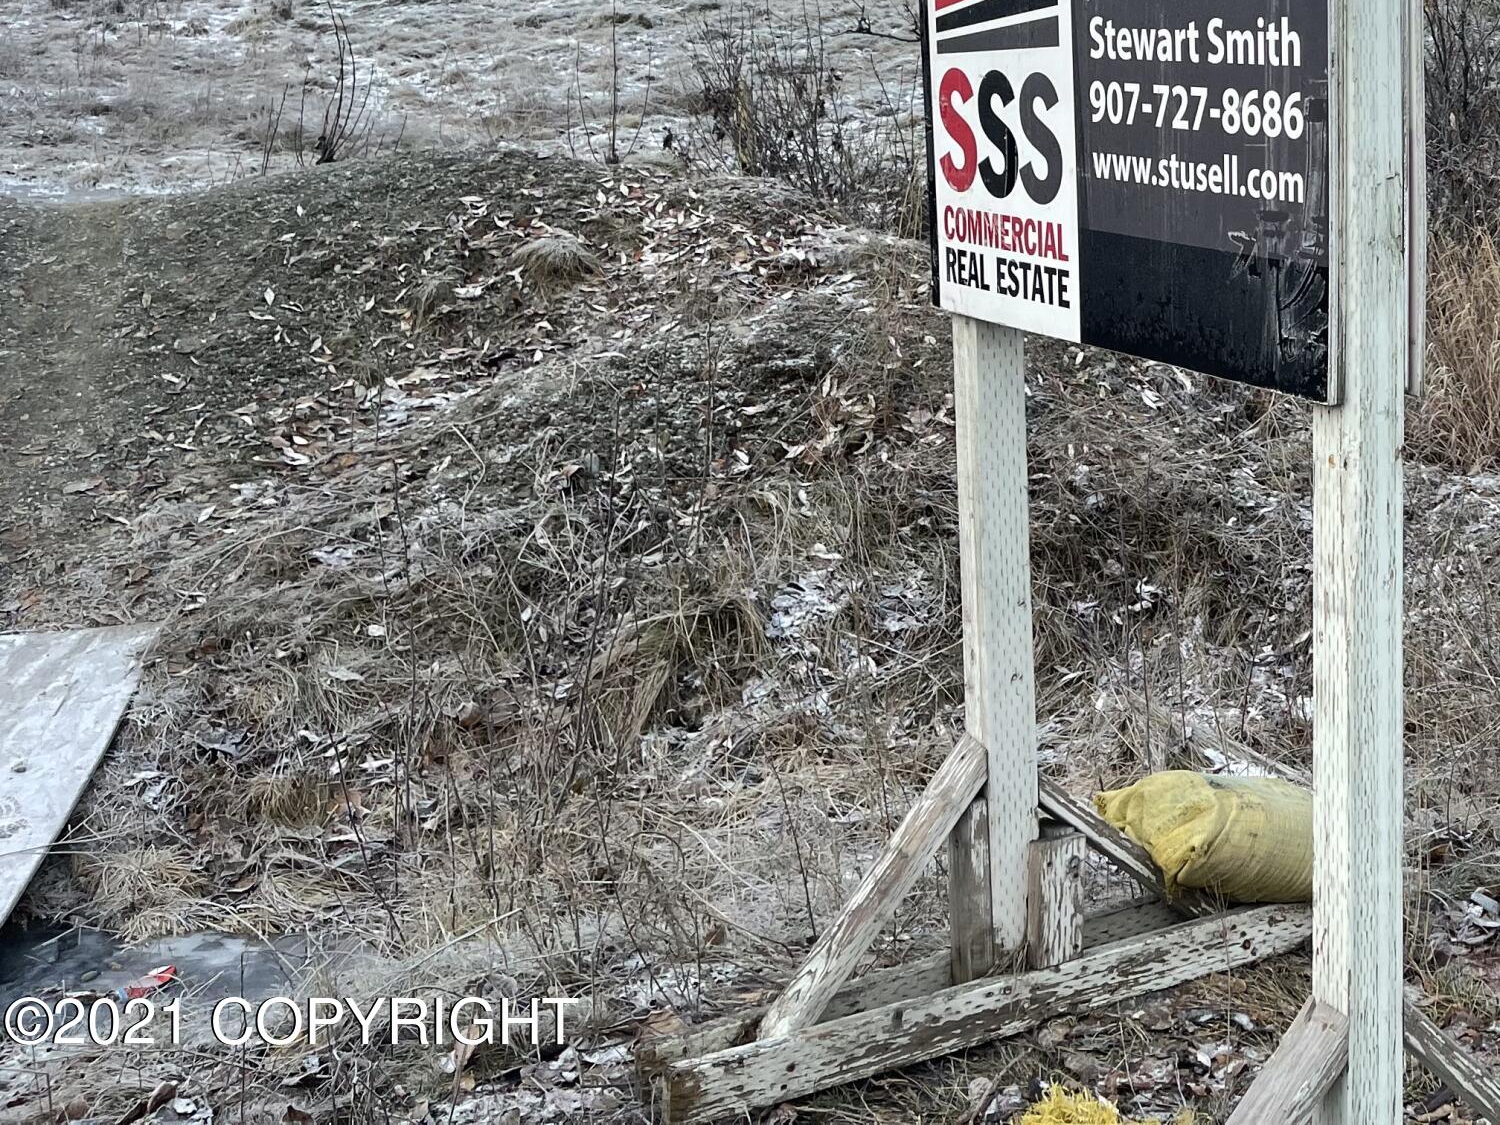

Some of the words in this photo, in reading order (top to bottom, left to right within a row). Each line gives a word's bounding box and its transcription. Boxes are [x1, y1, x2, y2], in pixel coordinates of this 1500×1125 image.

[1089, 16, 1199, 64] Stewart
[1207, 16, 1302, 67] Smith
[939, 67, 1063, 205] SSS
[1089, 80, 1304, 140] 907-727-8686
[1092, 148, 1304, 204] www.stusell.com
[944, 204, 1069, 262] COMMERCIAL
[945, 246, 990, 292] REAL
[997, 257, 1071, 309] ESTATE
